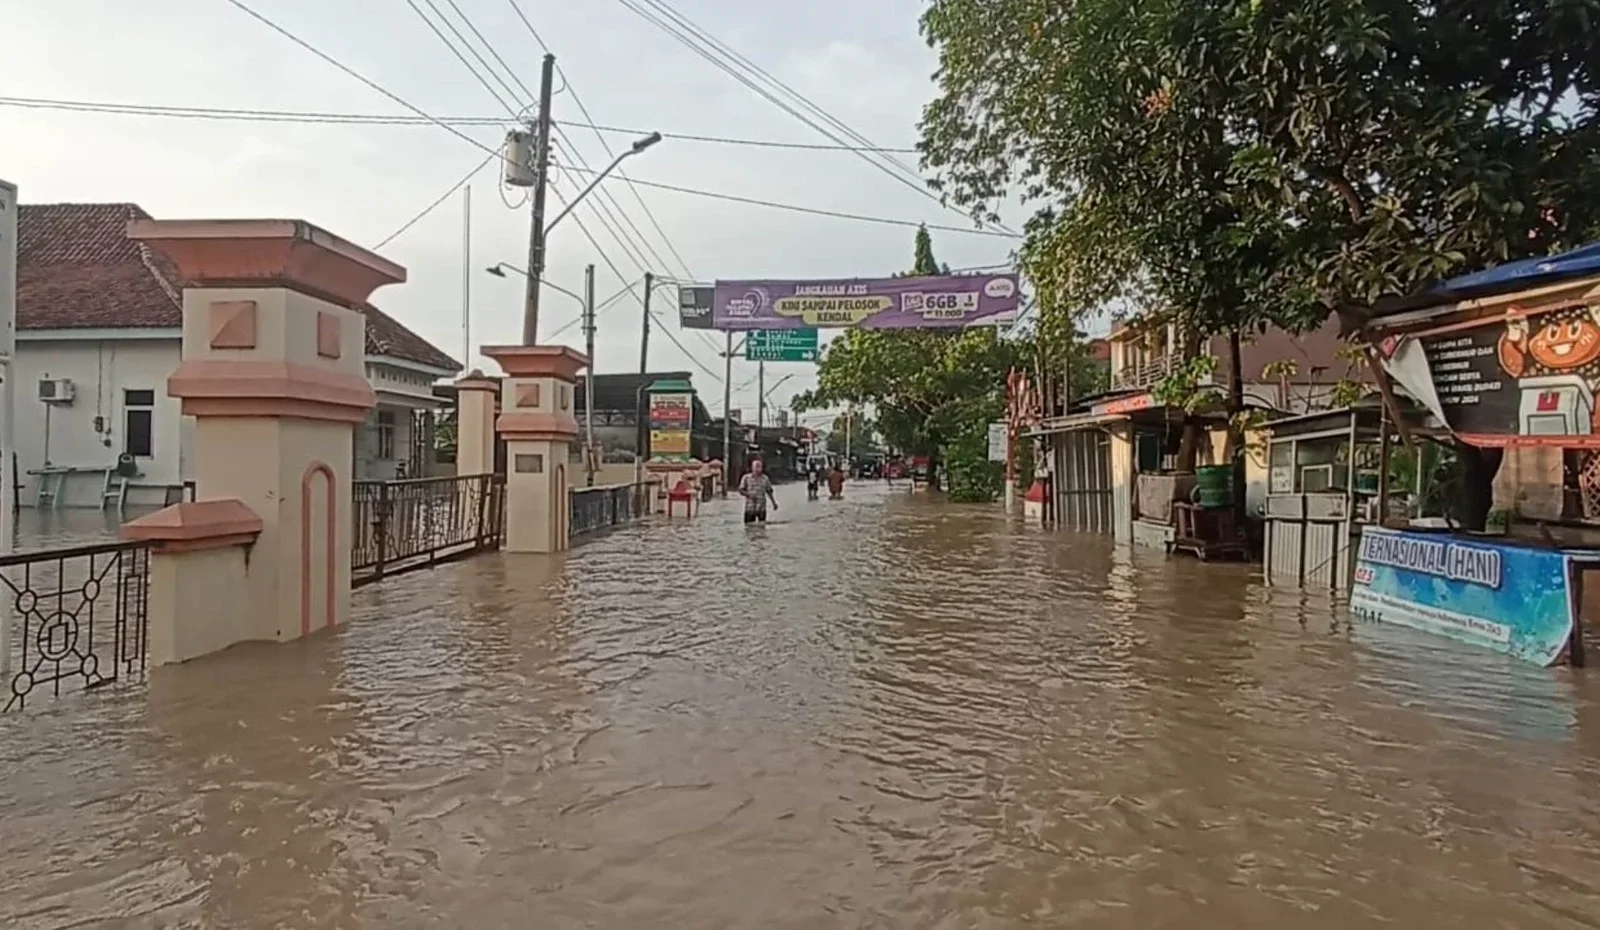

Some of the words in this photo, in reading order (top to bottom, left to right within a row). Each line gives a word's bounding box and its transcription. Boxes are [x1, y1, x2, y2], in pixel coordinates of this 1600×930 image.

[801, 300, 837, 311] SAMPAI
[838, 299, 881, 311] PELOSOK
[926, 294, 957, 309] 6GB
[817, 312, 853, 322] KENDAL
[1362, 534, 1446, 575] TERNASIONAL
[1447, 544, 1499, 586] (HANI)
